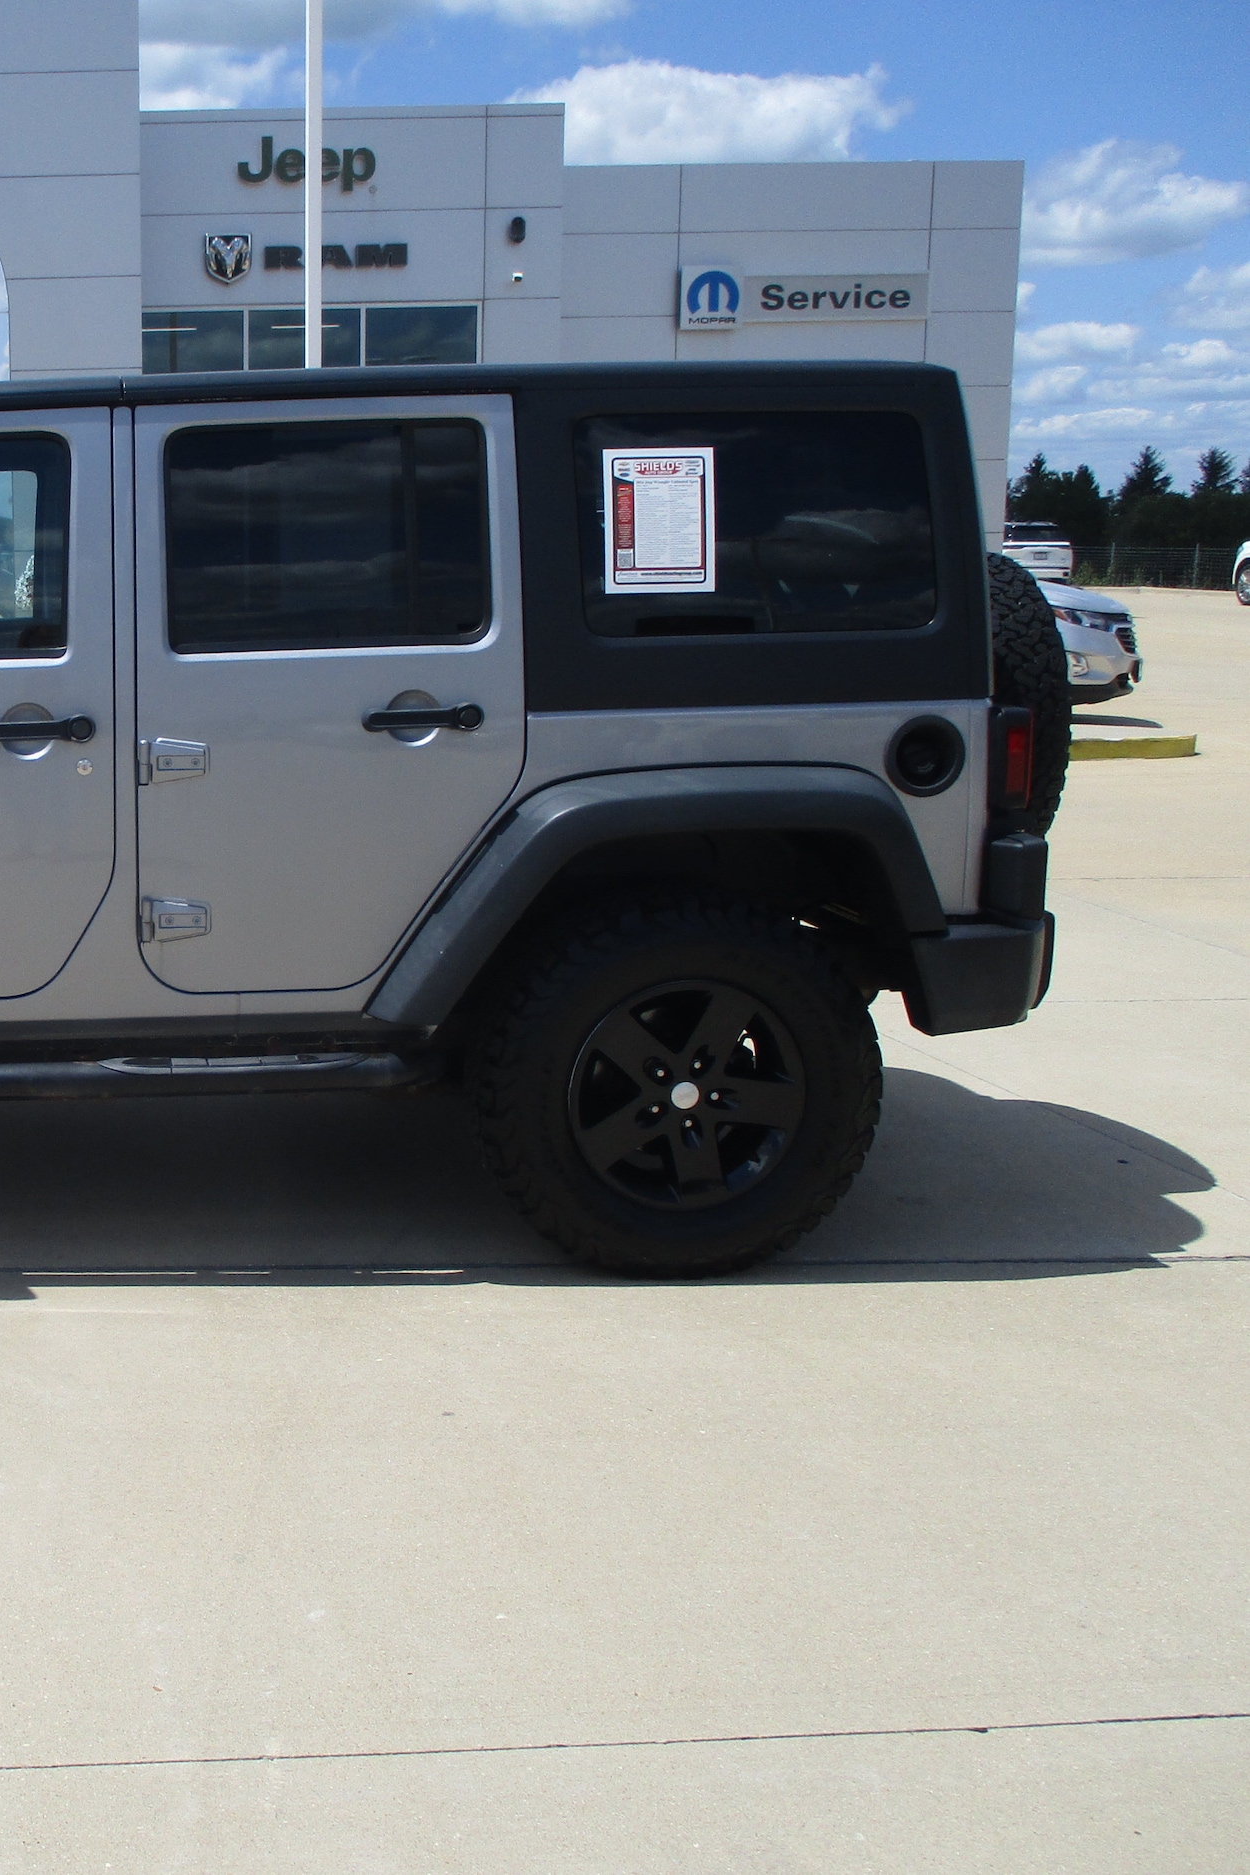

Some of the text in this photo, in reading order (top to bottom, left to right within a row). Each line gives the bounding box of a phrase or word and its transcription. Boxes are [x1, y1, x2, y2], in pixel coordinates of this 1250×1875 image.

[237, 136, 376, 192] Jeep
[264, 243, 408, 269] RAM
[760, 283, 911, 311] Service
[688, 317, 736, 325] MOPAR
[634, 461, 683, 471] SHIELDS
